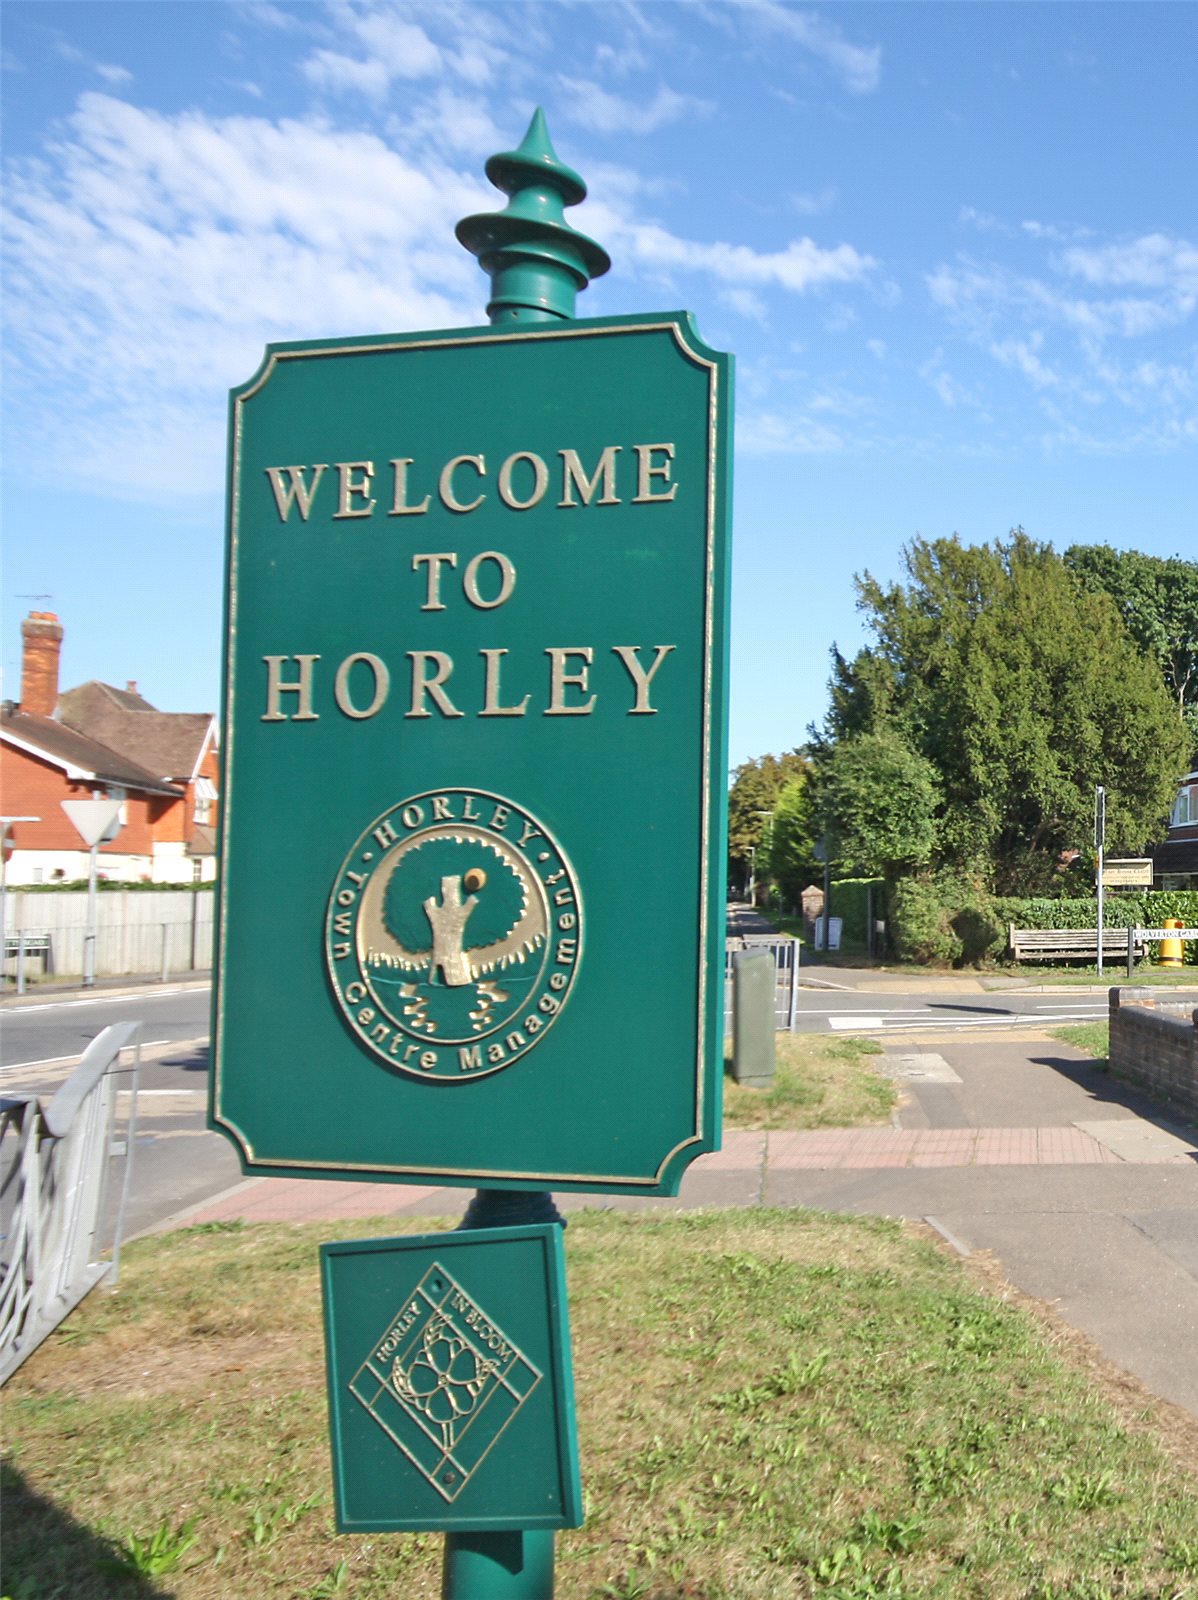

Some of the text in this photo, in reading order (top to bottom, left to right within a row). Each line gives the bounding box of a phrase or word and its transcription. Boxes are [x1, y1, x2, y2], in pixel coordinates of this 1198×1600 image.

[265, 442, 679, 523] WELCOME
[411, 550, 517, 610] TO
[260, 644, 678, 721] HORLEY
[372, 795, 543, 850] HORLEY
[1134, 929, 1180, 938] WOLVERTON
[333, 868, 577, 1071] Town Centre Management
[375, 1300, 422, 1363] HORLEY
[450, 1292, 512, 1363] IN BLOOM
